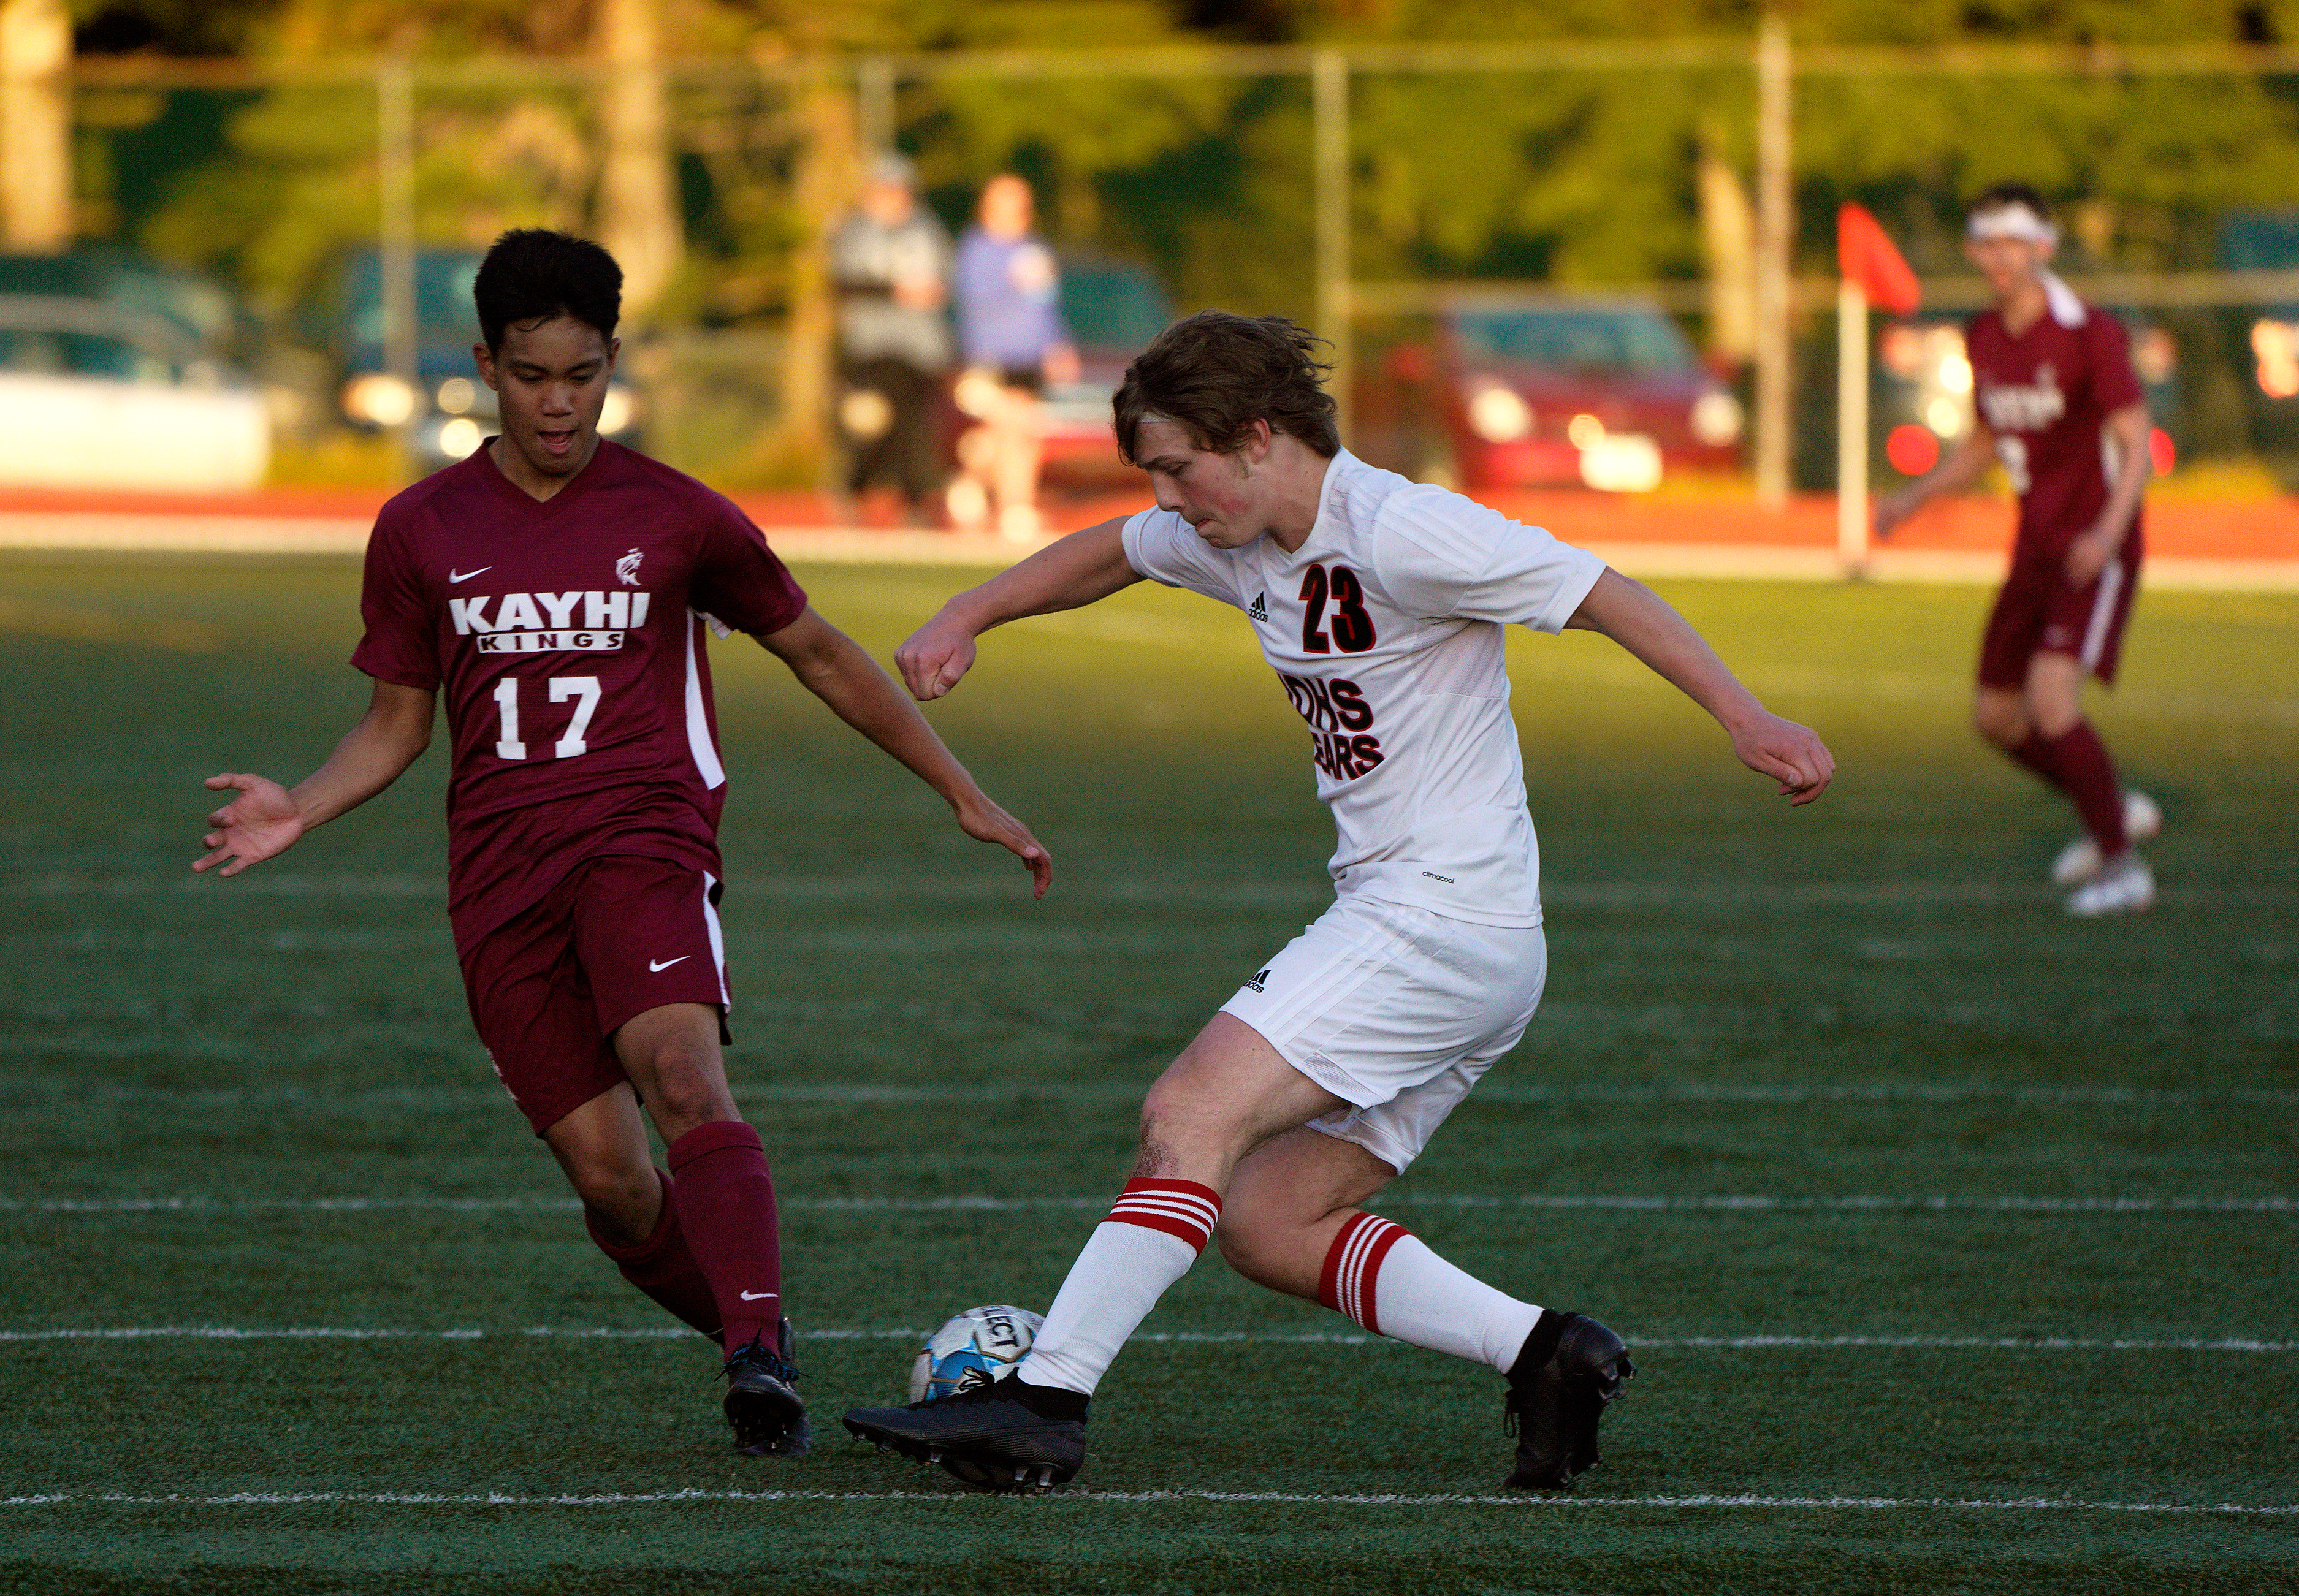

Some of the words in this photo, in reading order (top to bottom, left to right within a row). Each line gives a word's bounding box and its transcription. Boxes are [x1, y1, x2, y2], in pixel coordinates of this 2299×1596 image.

[449, 591, 650, 635] KAYHI
[1299, 564, 1376, 654] 23
[481, 633, 621, 650] KINGS
[493, 676, 602, 760] 17
[1278, 674, 1374, 732] DHS
[1311, 732, 1385, 781] EARS
[1422, 872, 1455, 884] climacool
